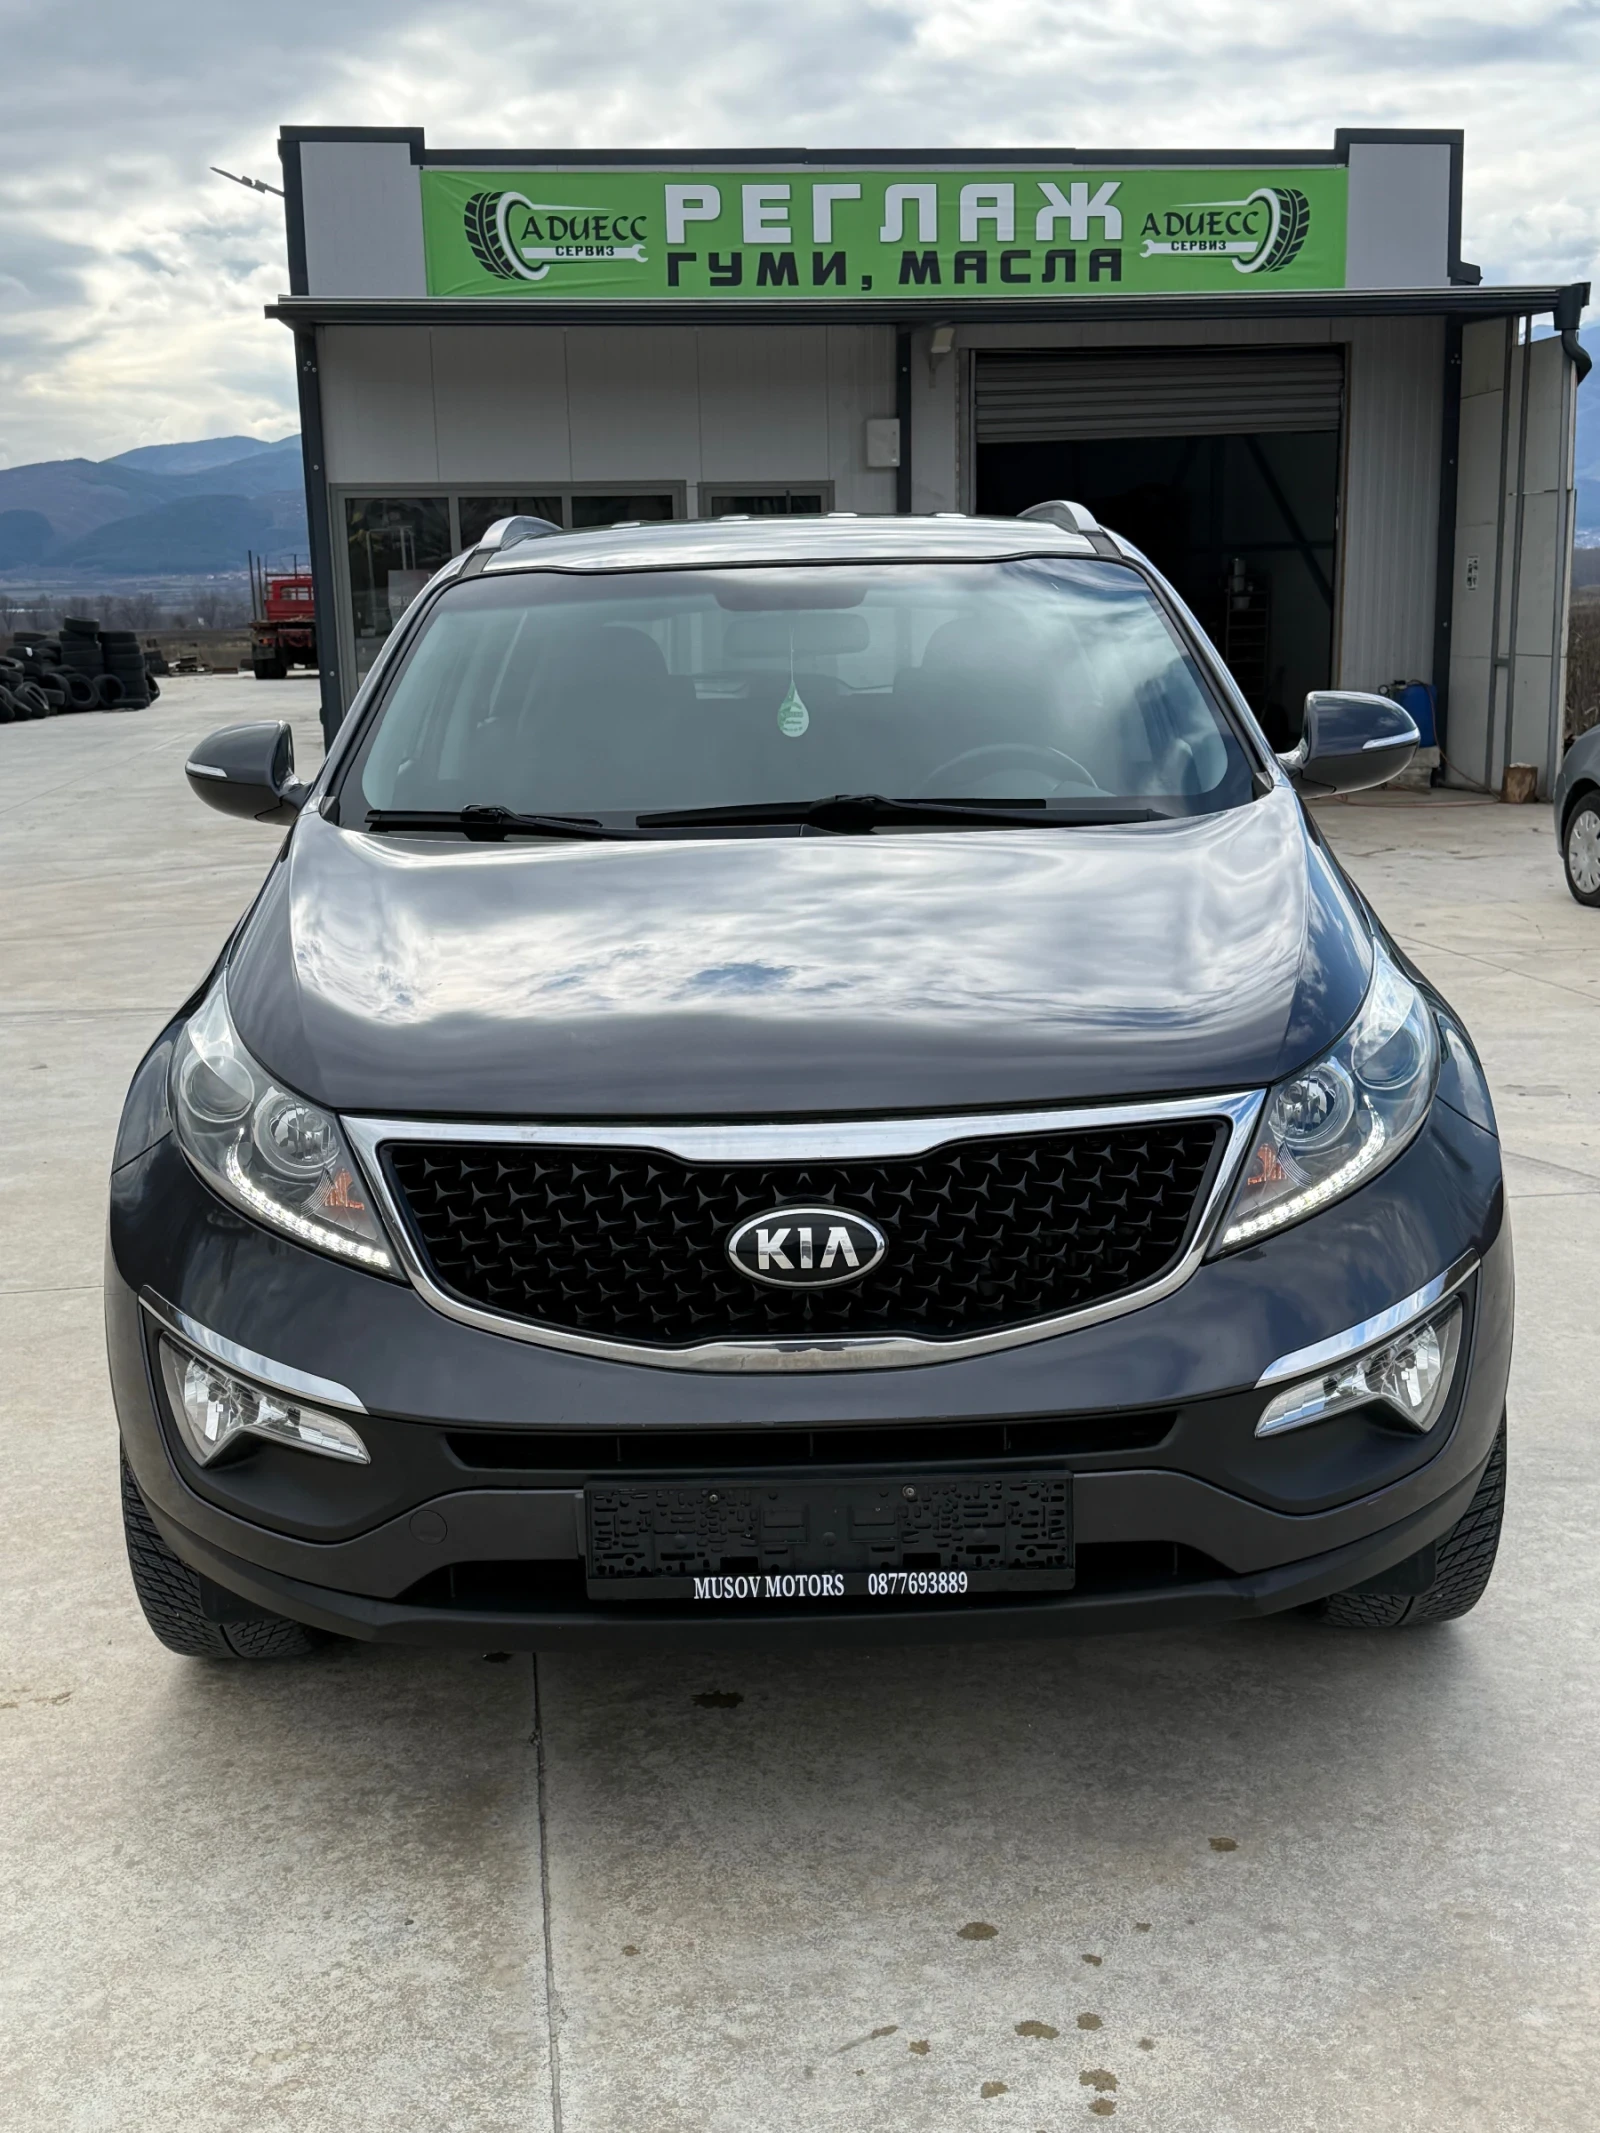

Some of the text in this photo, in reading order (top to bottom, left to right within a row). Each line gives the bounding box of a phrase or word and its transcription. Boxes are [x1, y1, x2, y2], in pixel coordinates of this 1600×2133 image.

[664, 182, 1123, 244] РЕГЛАЖ
[555, 245, 615, 257] СЕРВИЗ
[1170, 240, 1227, 251] СЕРВИЗ
[667, 248, 1122, 291] ГУМИ, МАСЛА
[755, 1226, 860, 1270] KIA
[693, 1571, 968, 1599] MUSOV MOTORS 0877693889
